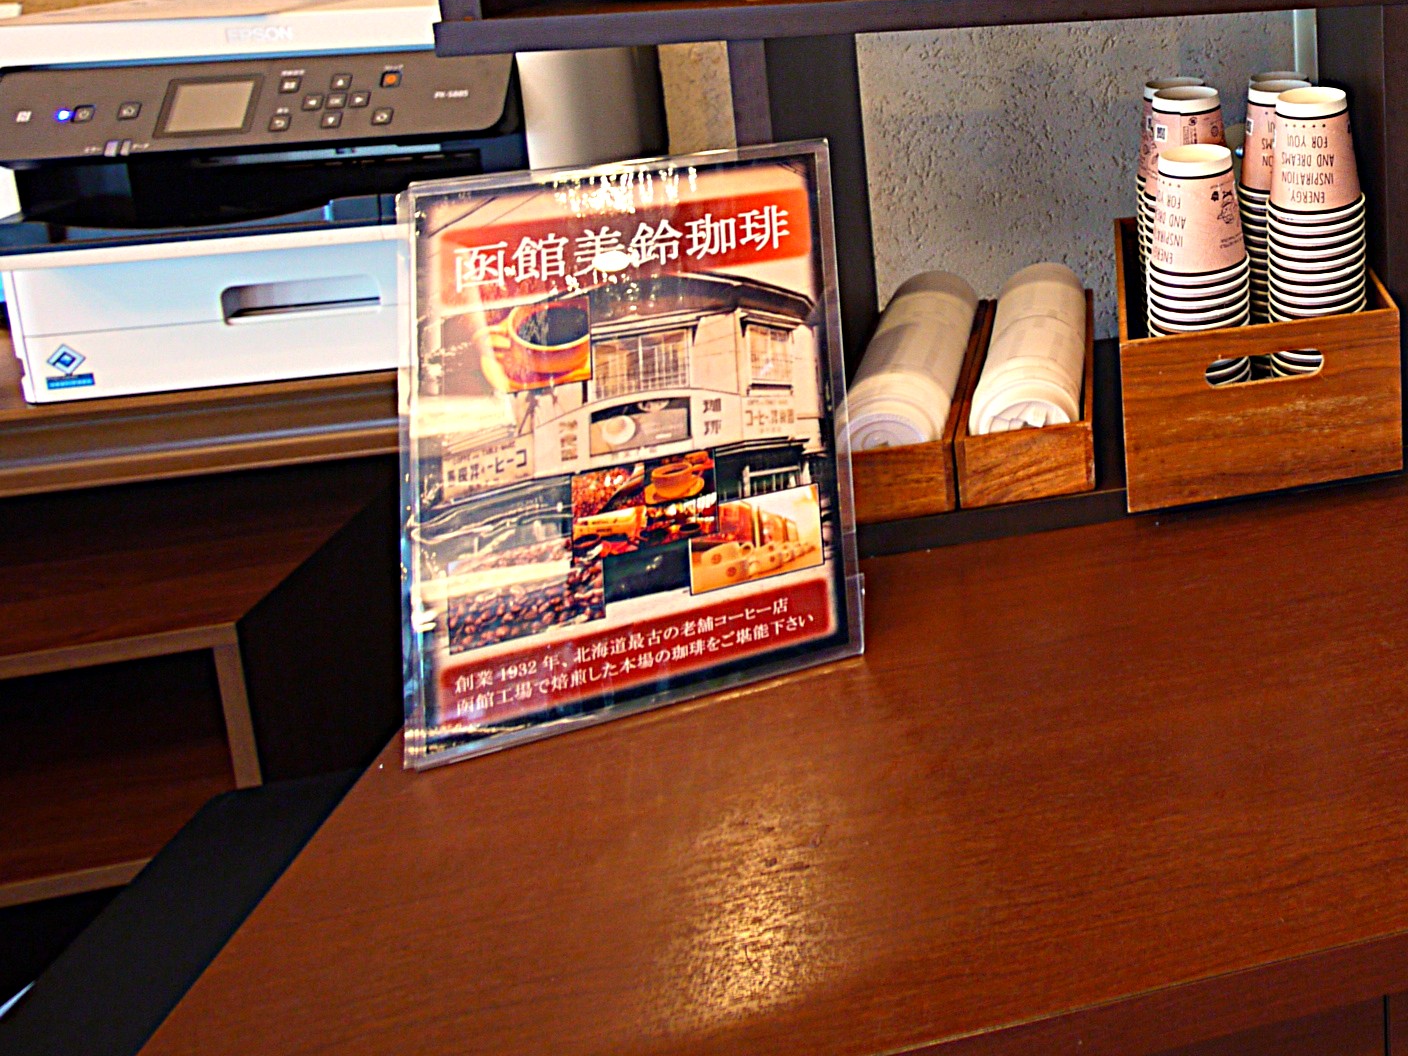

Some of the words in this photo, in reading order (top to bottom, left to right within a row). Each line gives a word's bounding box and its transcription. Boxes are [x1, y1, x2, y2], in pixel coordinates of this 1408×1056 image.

[225, 26, 294, 43] EPSON
[1312, 135, 1328, 149] FOR
[1281, 151, 1312, 167] DREAMS
[1317, 153, 1334, 167] AND
[1281, 170, 1334, 186] INSPIRATION
[1169, 213, 1186, 229] AND
[453, 204, 790, 293] 函館美鈴珈琲
